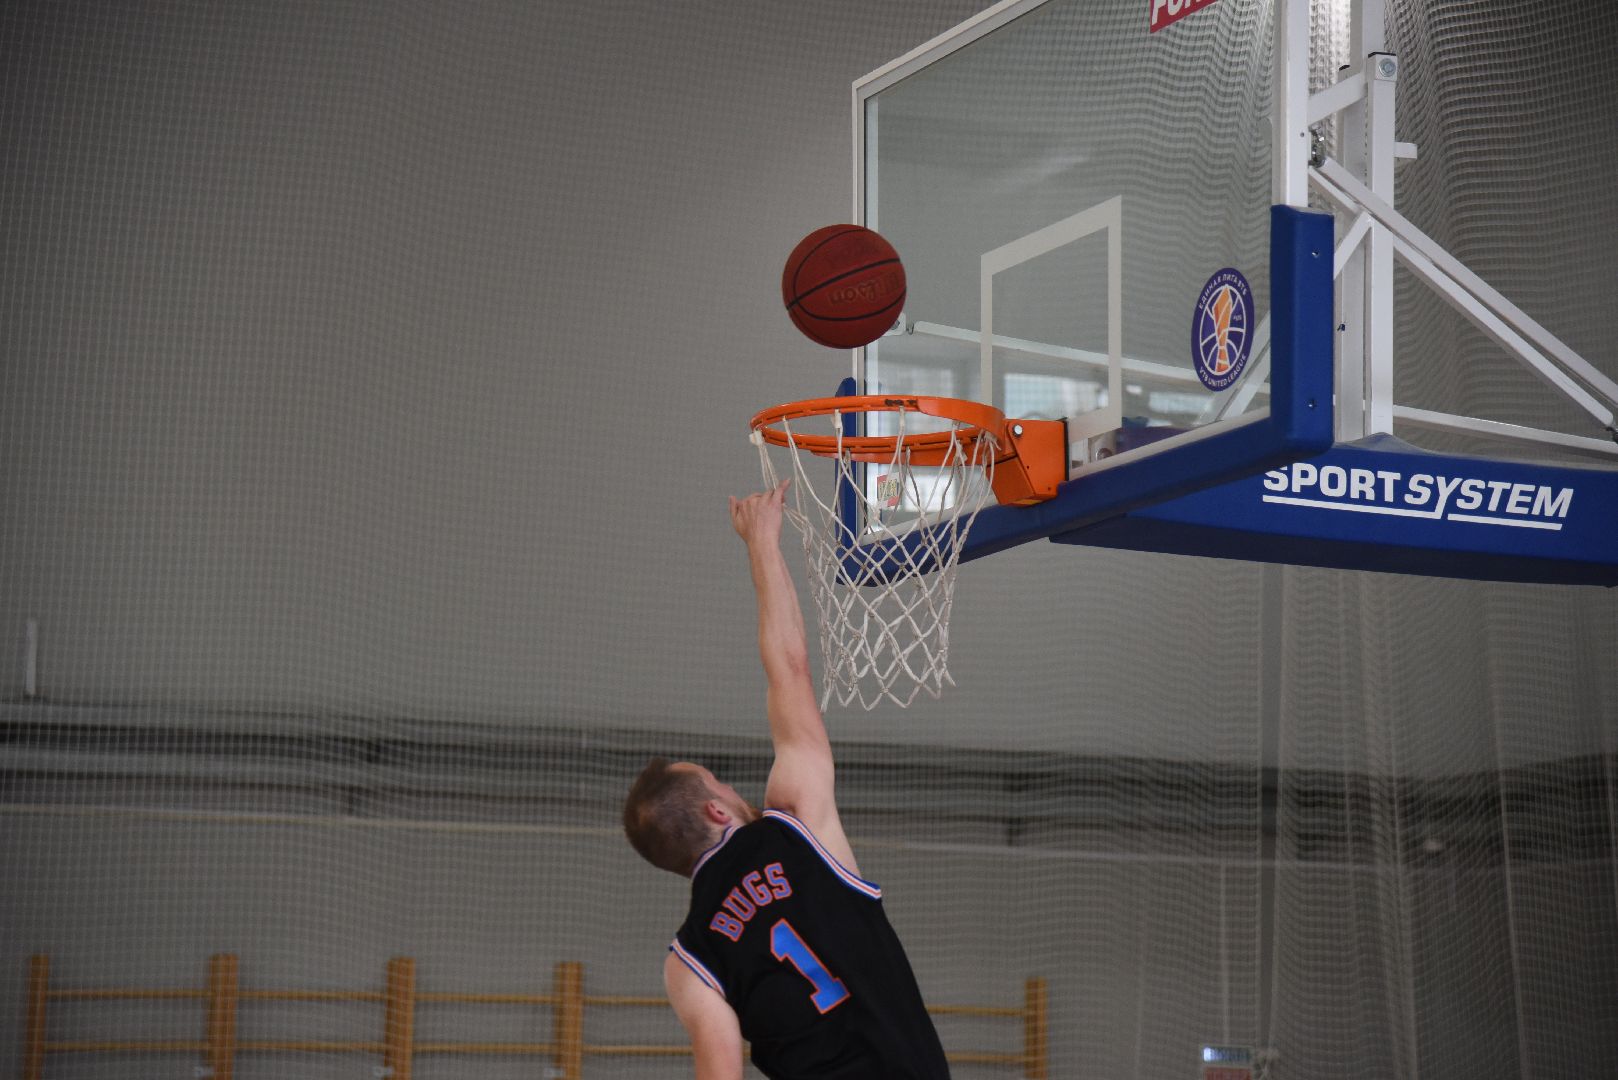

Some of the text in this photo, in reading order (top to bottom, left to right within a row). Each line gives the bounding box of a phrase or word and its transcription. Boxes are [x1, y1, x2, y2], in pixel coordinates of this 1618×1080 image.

[1208, 378, 1228, 388] UNITED
[1227, 354, 1247, 383] LEAGUE
[1263, 462, 1574, 519] SPORT SYSTEM
[709, 862, 793, 943] BUGS
[770, 917, 852, 1015] 1
